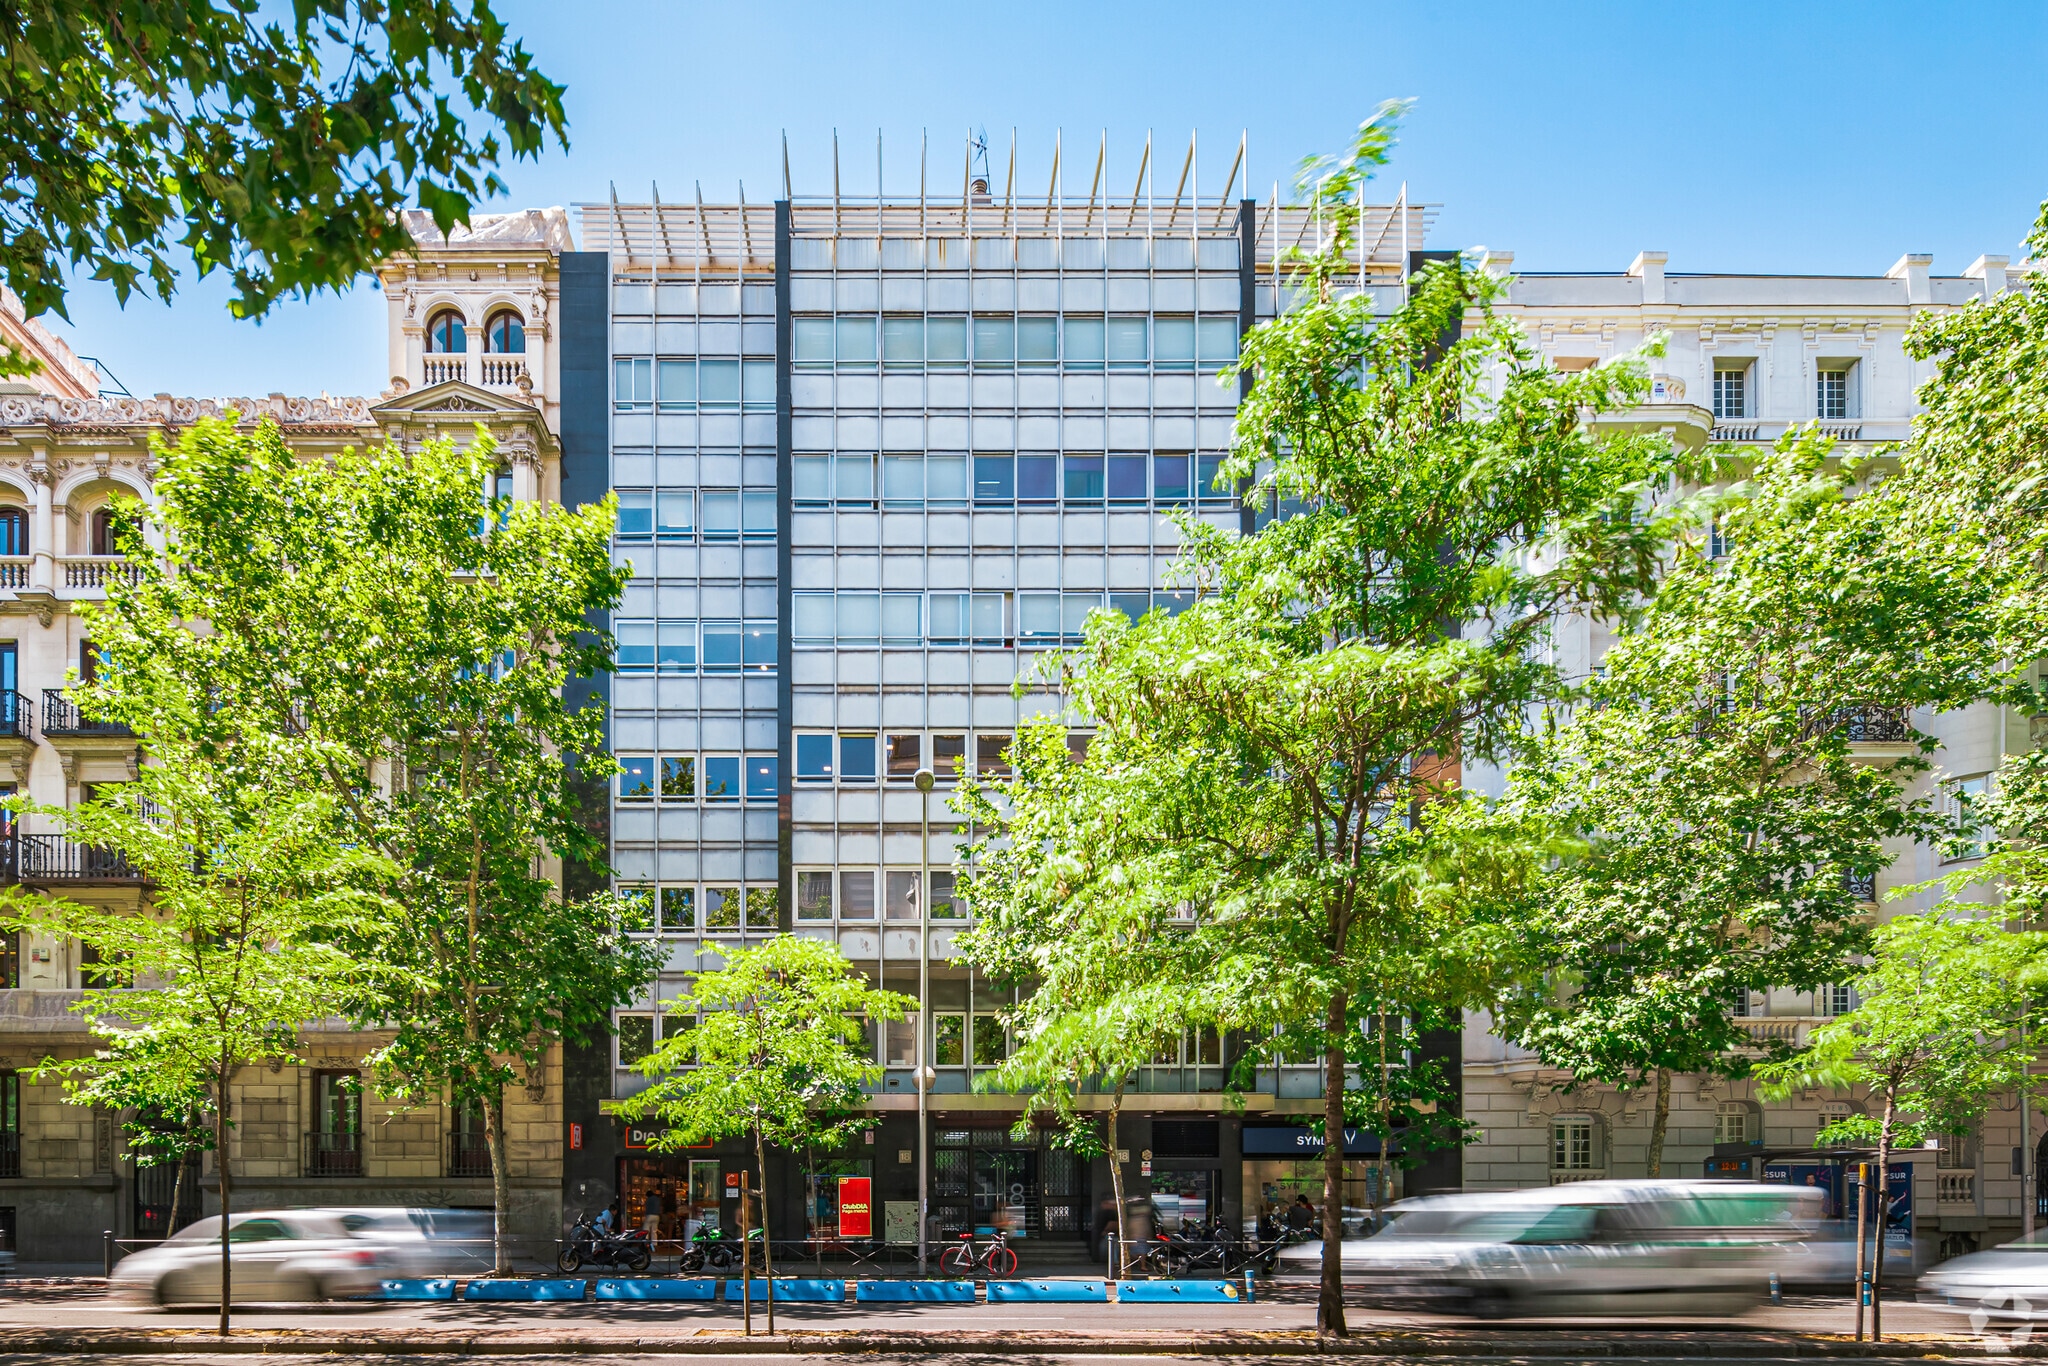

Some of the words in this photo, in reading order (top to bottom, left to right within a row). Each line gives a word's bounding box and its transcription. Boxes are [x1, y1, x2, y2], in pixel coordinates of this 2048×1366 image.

[1825, 1104, 1849, 1112] NEWS
[1296, 1136, 1326, 1146] SYNL
[901, 1152, 910, 1161] 18
[1118, 1152, 1128, 1161] 18
[1765, 1171, 1787, 1179] ESUR
